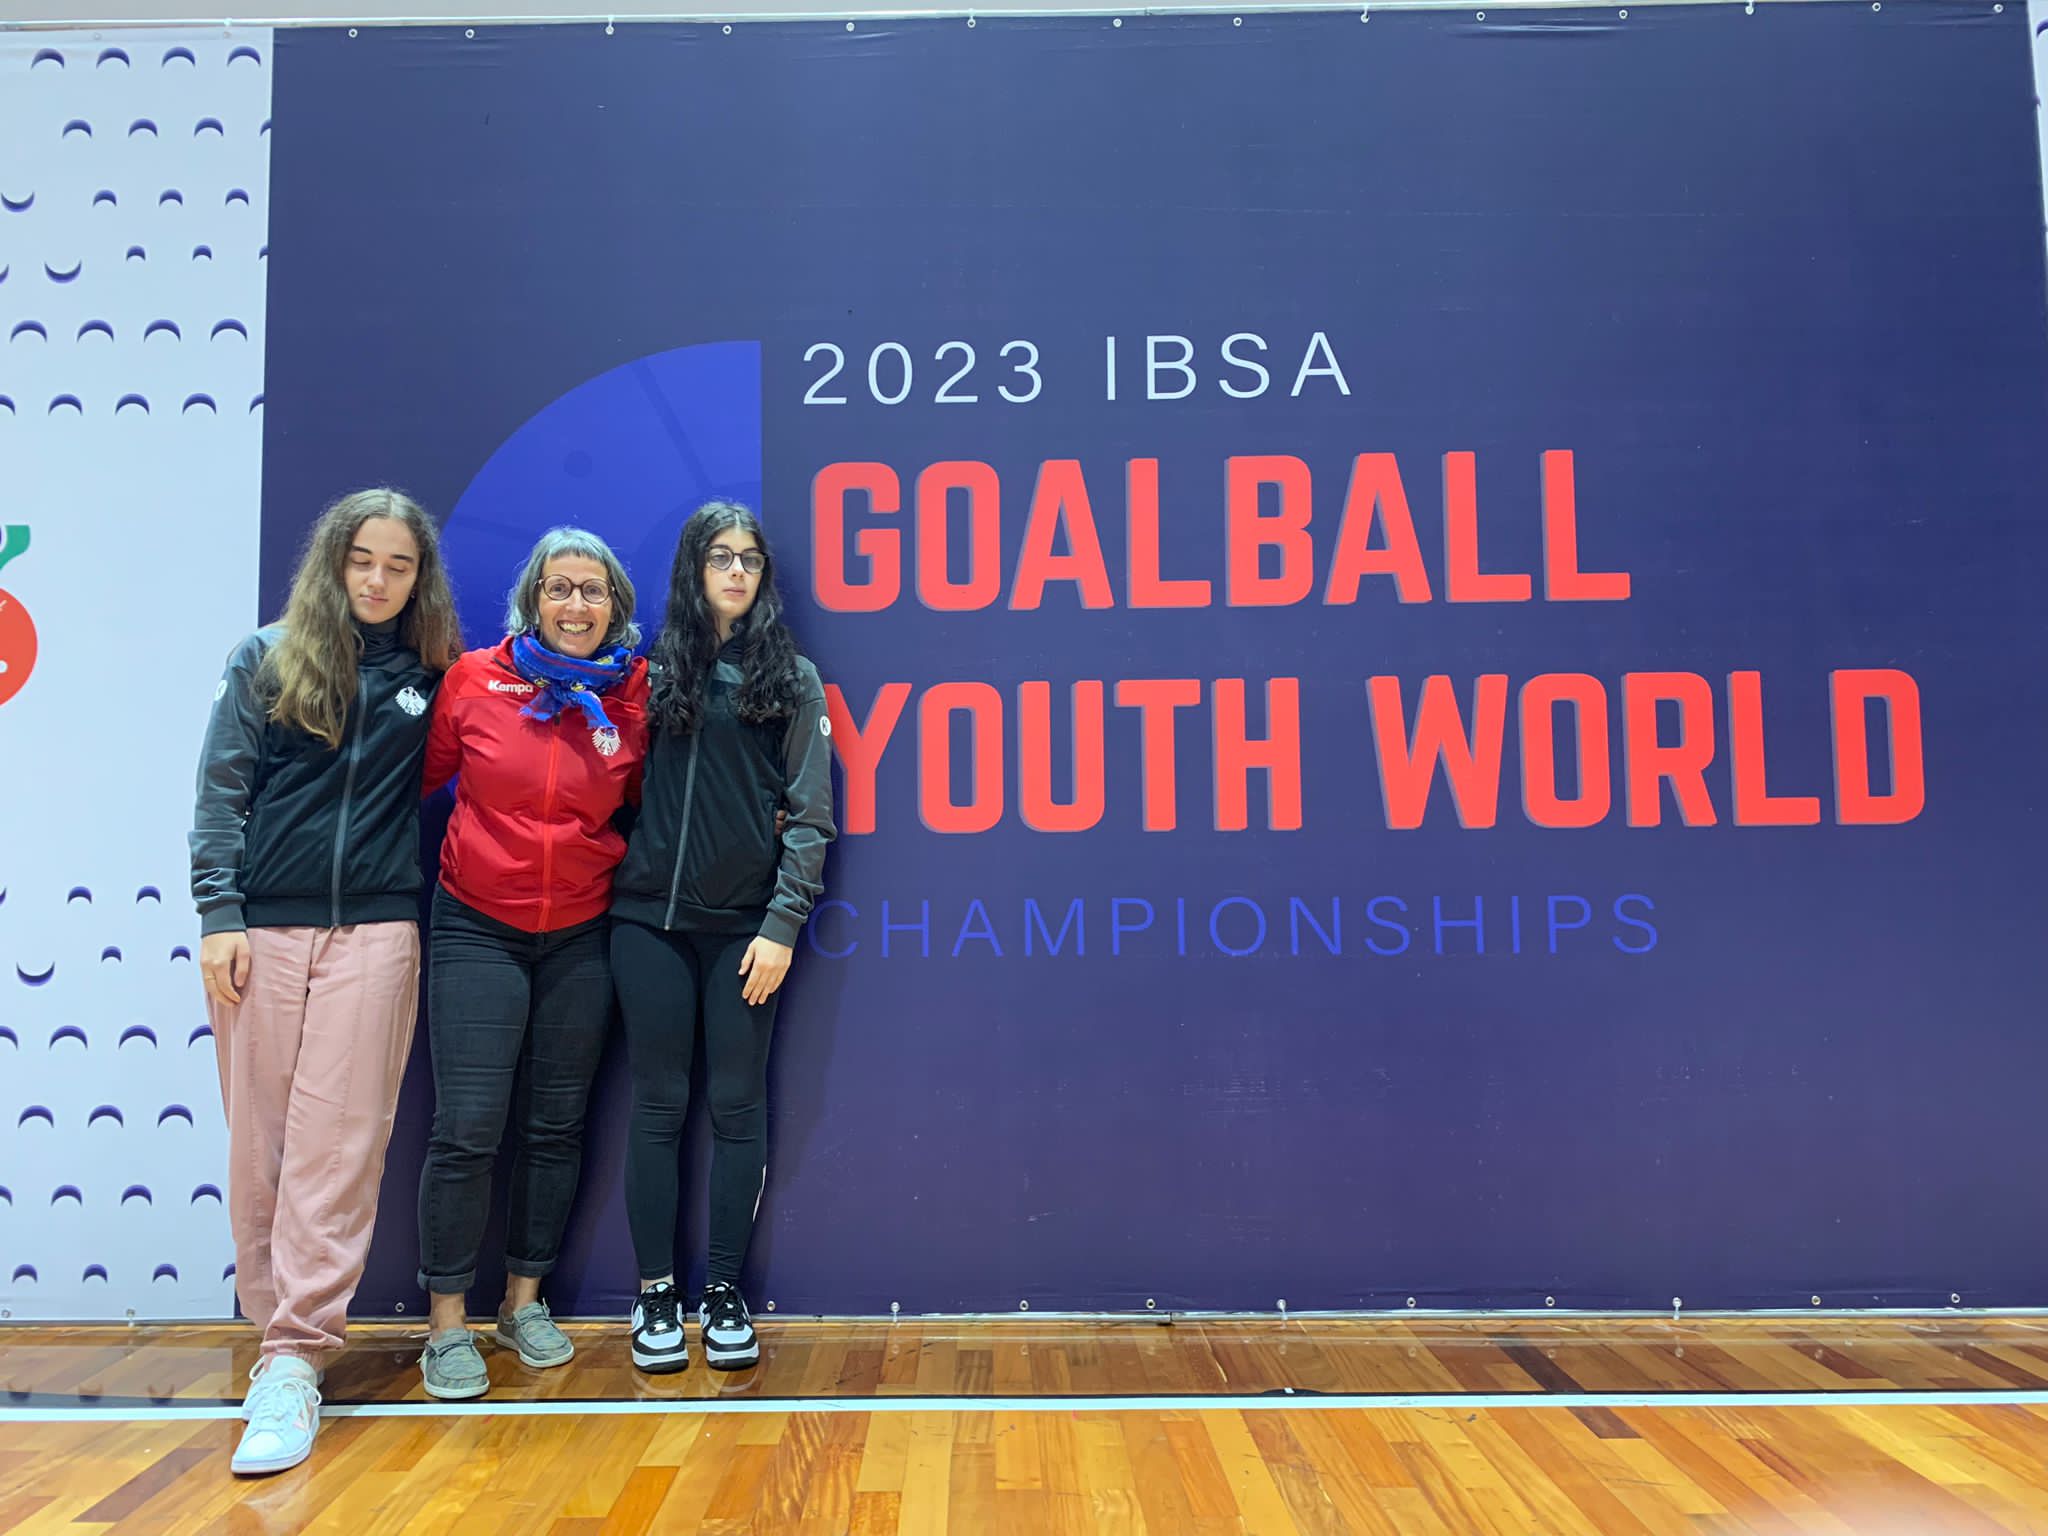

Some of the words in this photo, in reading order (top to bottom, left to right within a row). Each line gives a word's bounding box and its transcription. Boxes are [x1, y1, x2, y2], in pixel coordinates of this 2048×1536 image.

[802, 340, 1043, 405] 2023
[1106, 332, 1351, 400] IBSA
[811, 449, 1631, 612] GOALBALL
[824, 677, 1302, 835] YOUTH
[1366, 669, 1925, 829] WORLD
[807, 893, 1659, 959] CHAMPIONSHIPS
